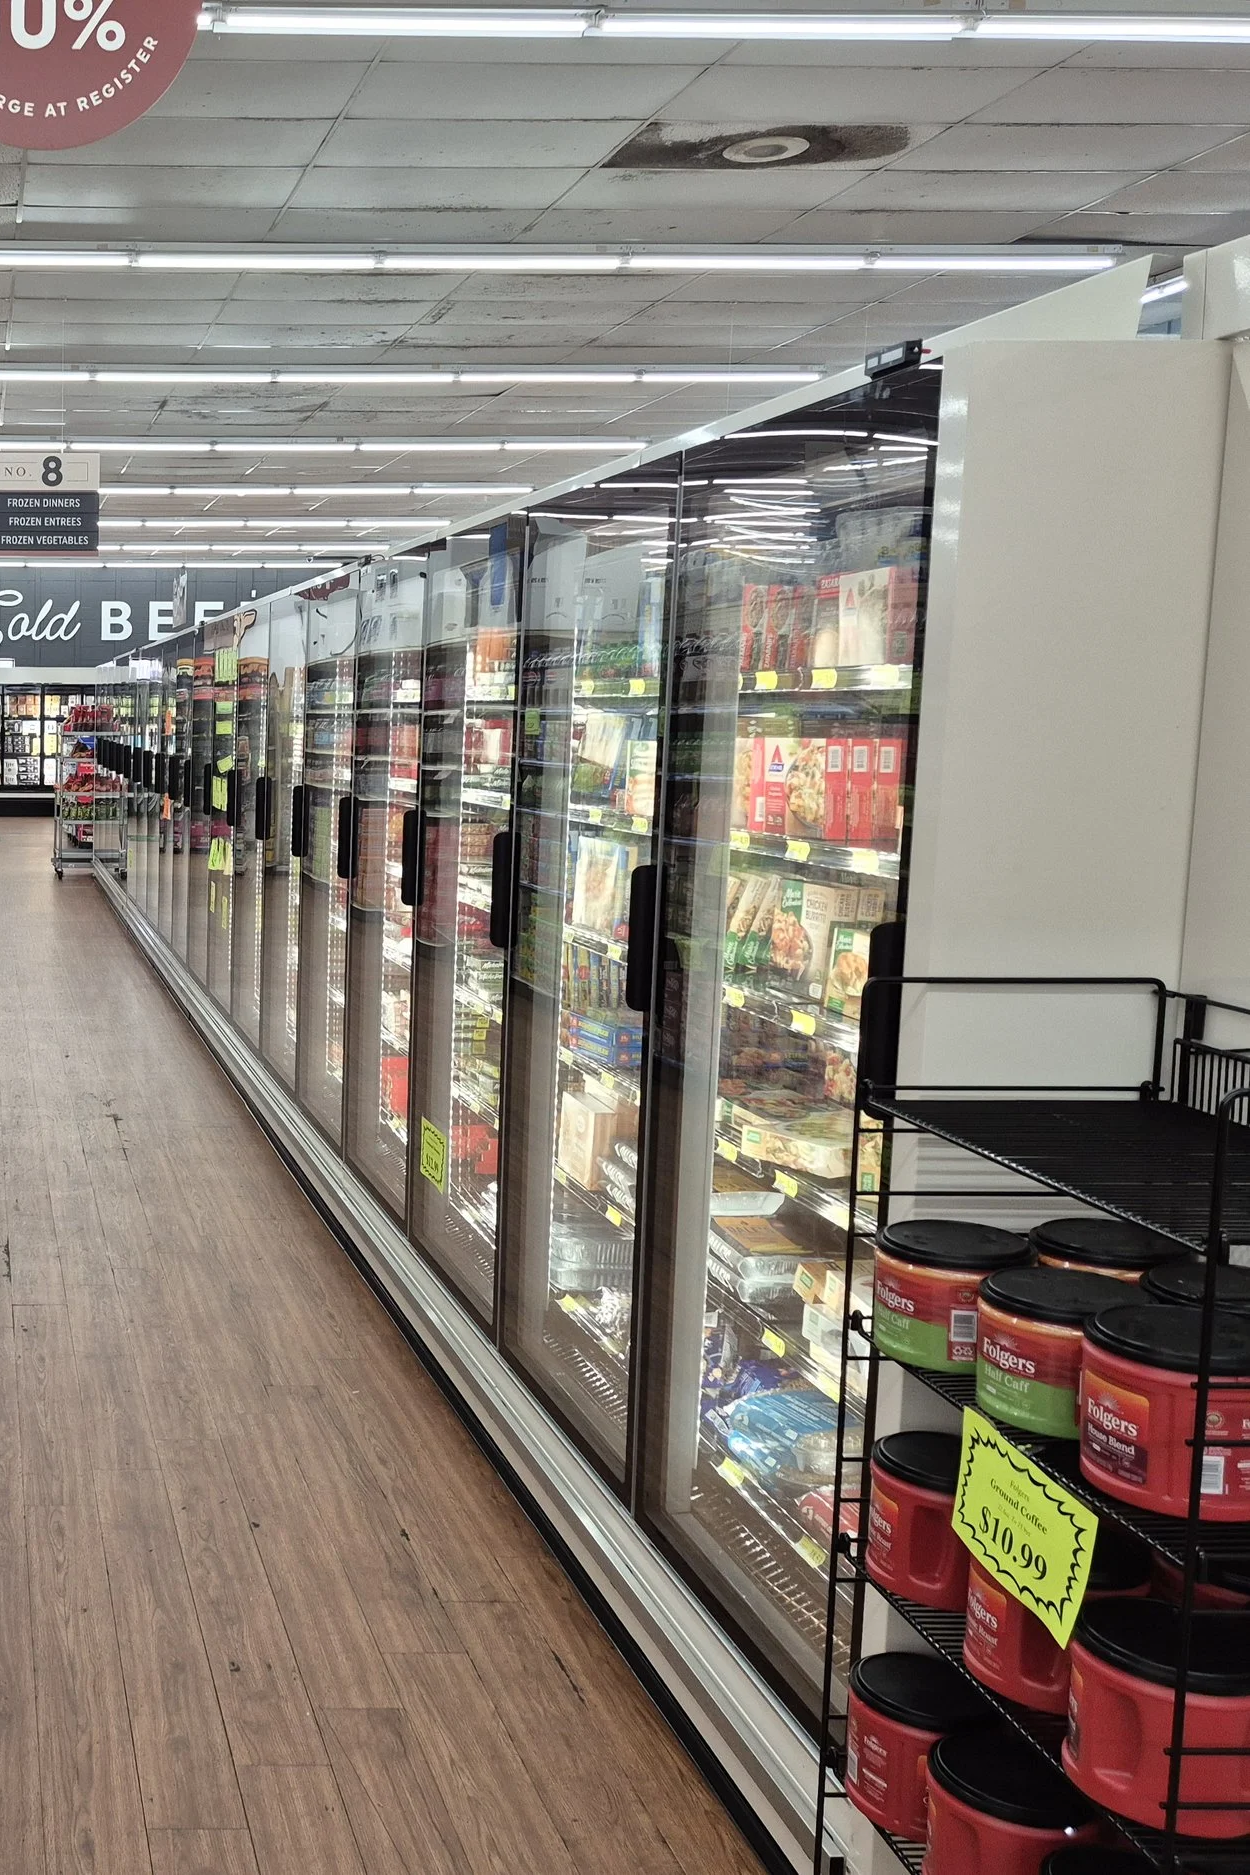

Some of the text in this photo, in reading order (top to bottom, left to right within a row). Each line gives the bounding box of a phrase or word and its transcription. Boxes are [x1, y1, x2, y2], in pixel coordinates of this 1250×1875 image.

[44, 102, 68, 118] AT
[76, 35, 159, 112] REGISTER
[4, 466, 32, 477] NO.
[41, 455, 63, 487] 8
[7, 498, 80, 508] FROZEN DINNERS
[8, 517, 82, 526] FROZEN ENTREES
[1, 536, 89, 545] FROZEN VEGETABLES
[101, 600, 254, 641] BEE
[876, 1279, 915, 1313] Folgers
[983, 1336, 1036, 1375] Folgers
[984, 1363, 1031, 1394] Half Caff
[1088, 1397, 1139, 1437] Folgers
[1087, 1423, 1136, 1456] House Blend
[990, 1478, 1020, 1511] Ground
[1020, 1505, 1049, 1536] Coffee
[1009, 1479, 1030, 1503] Folgers
[978, 1505, 1048, 1581] $10.99
